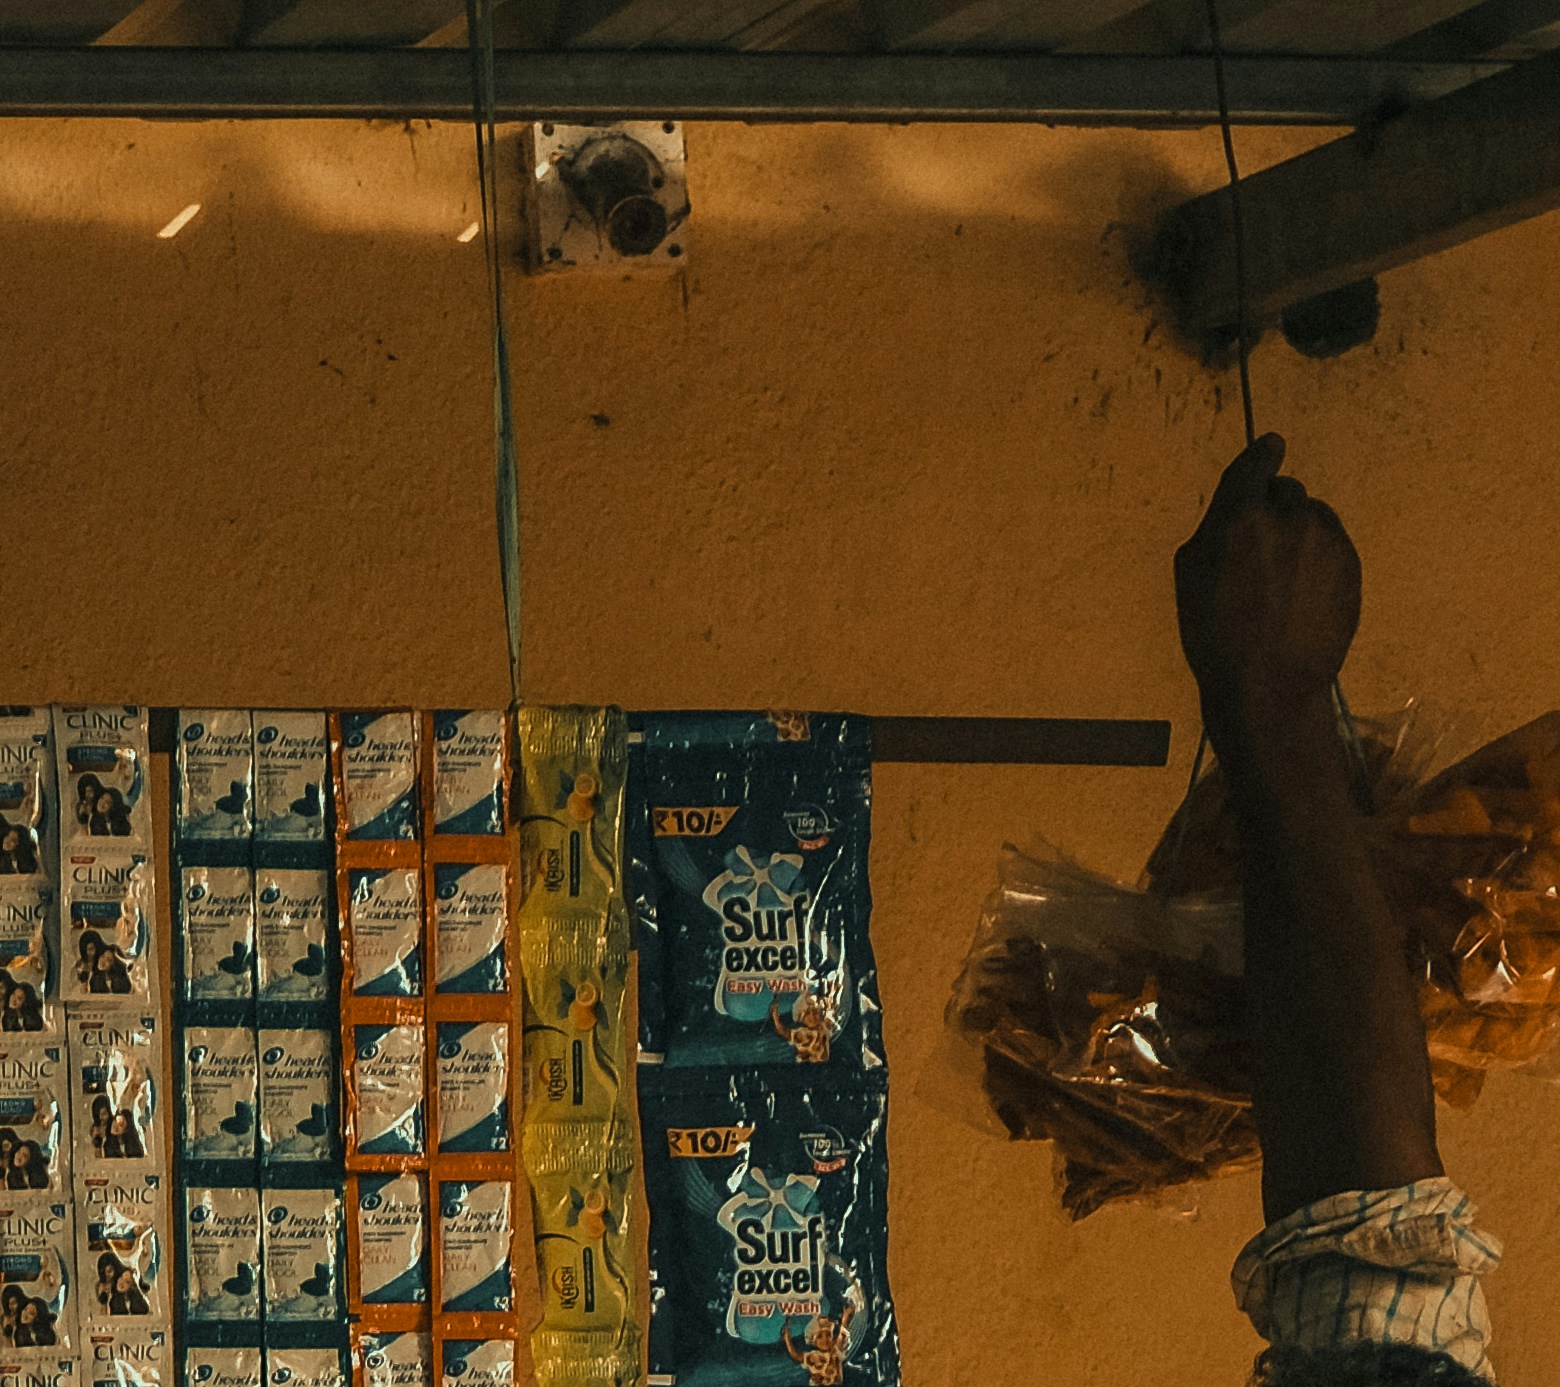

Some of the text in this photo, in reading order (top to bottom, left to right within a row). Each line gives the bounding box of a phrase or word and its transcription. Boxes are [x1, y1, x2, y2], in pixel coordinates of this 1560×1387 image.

[185, 745, 248, 759] shoulders
[259, 749, 323, 761] shoulders
[722, 895, 810, 943] Surf
[727, 979, 763, 994] Easy
[737, 1216, 824, 1265] Surf
[737, 1264, 822, 1295] excel
[740, 1299, 821, 1318] Easy Wash
